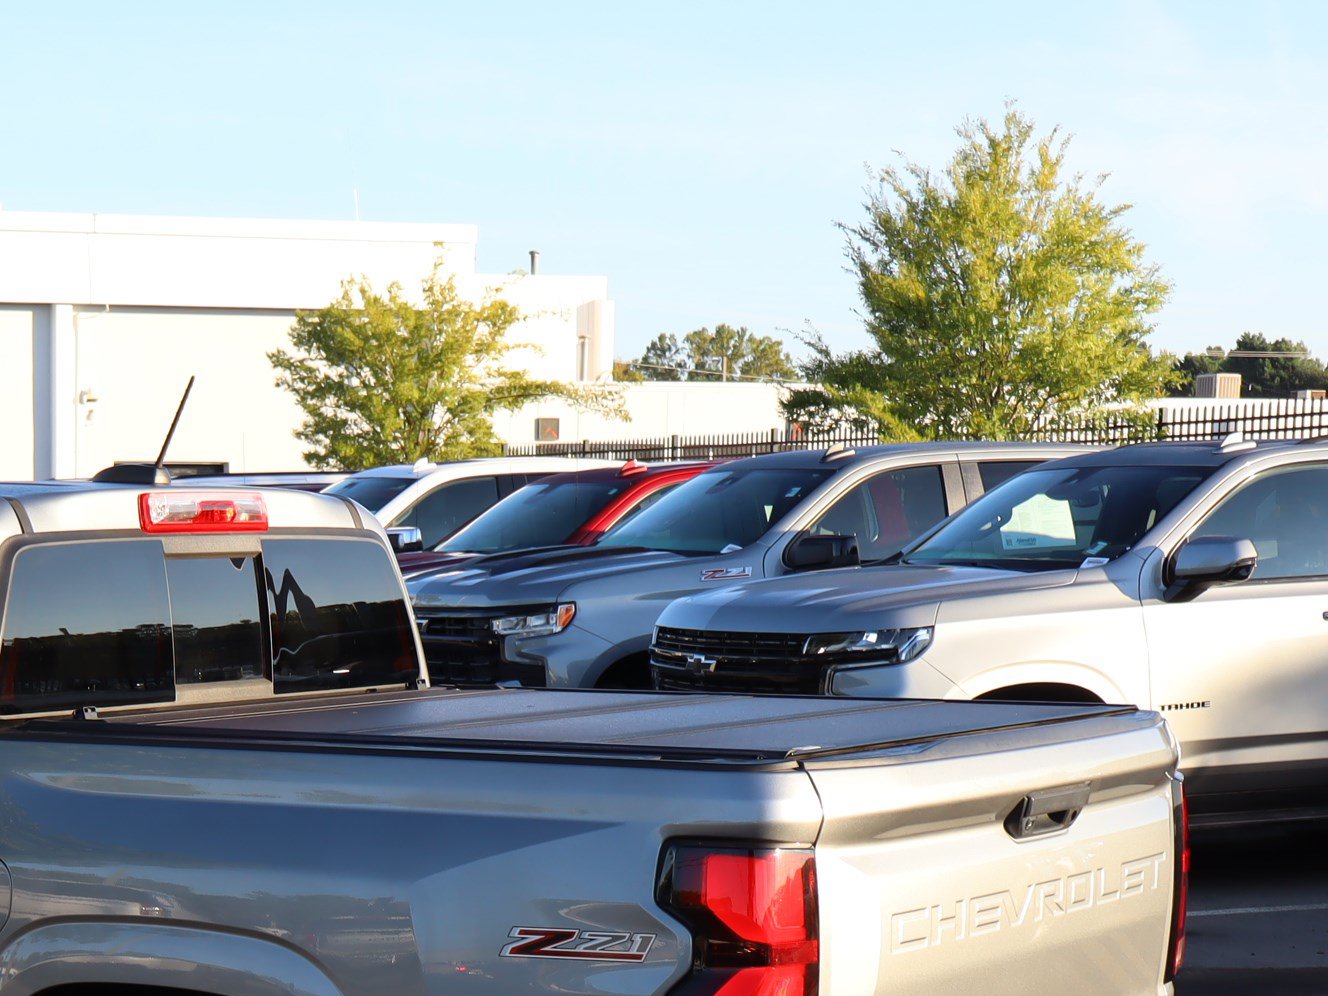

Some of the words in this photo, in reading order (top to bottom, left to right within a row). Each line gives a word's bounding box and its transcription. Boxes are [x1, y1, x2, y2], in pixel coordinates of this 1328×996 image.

[701, 566, 752, 581] Z71
[1160, 700, 1211, 711] TAHOE
[891, 851, 1167, 954] CHEVROLET
[499, 926, 657, 963] Z71
